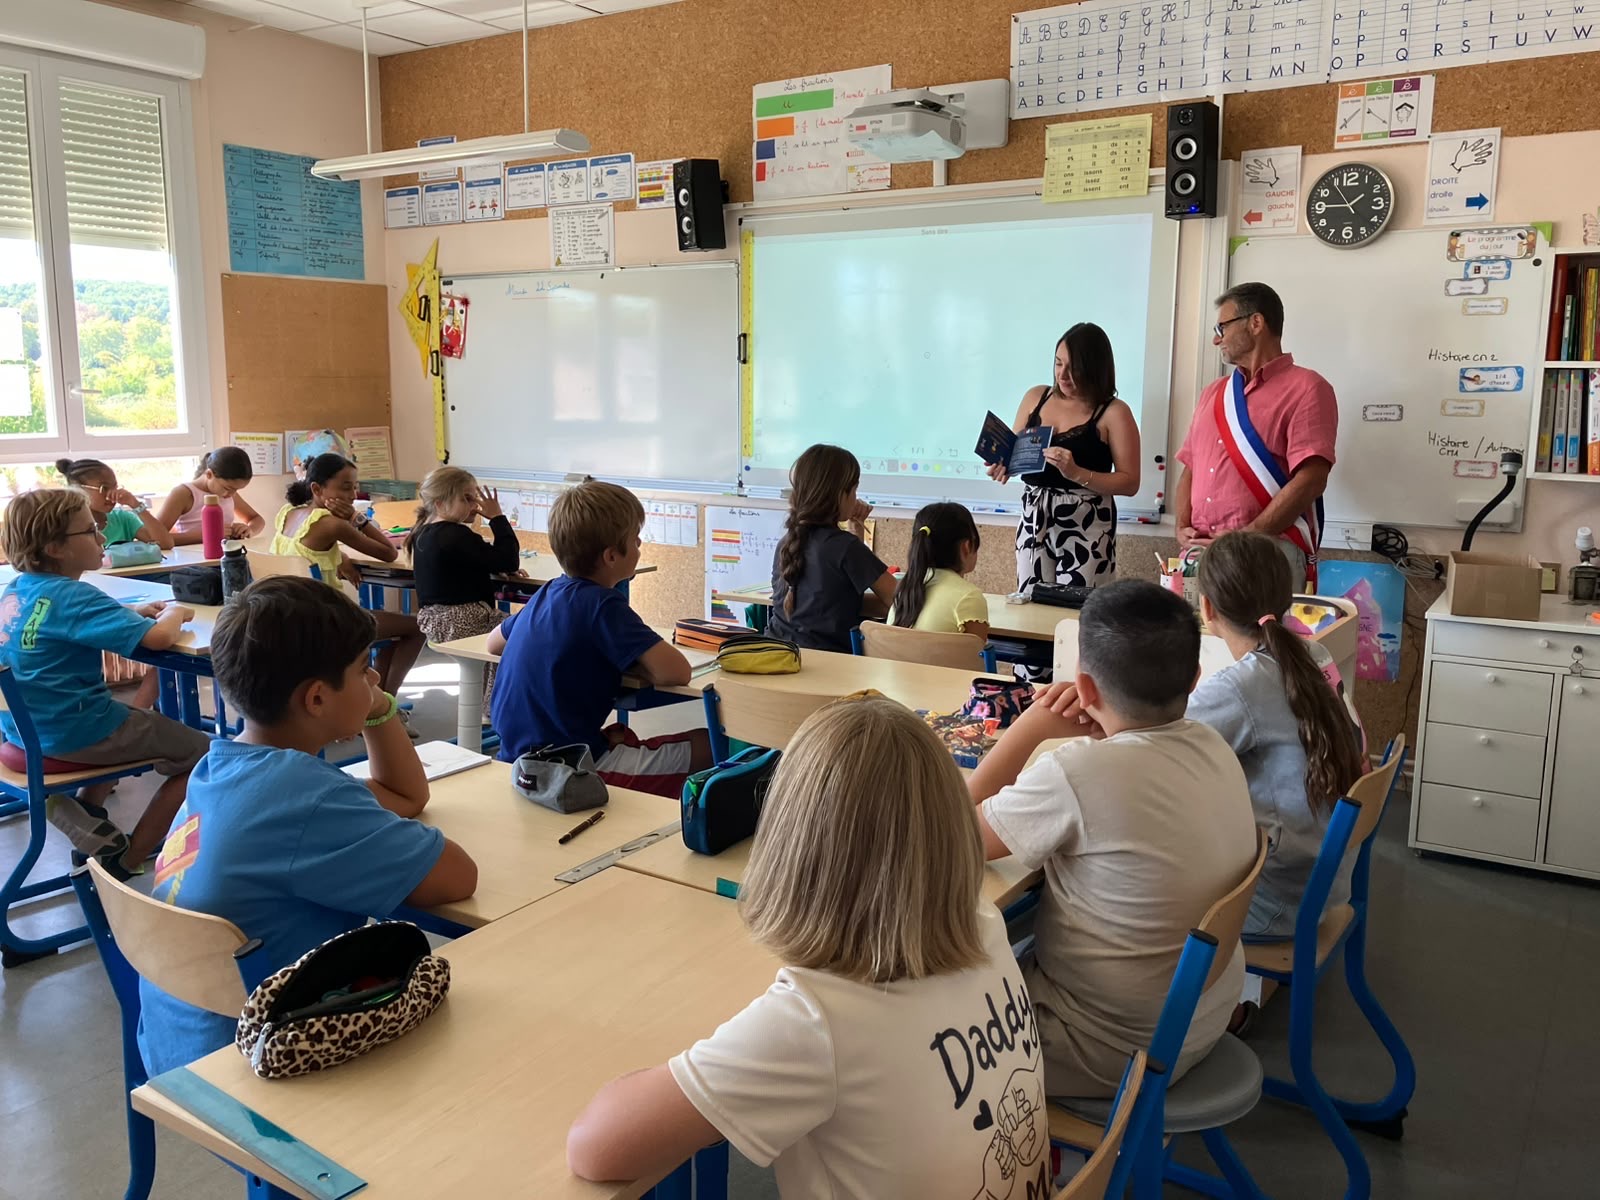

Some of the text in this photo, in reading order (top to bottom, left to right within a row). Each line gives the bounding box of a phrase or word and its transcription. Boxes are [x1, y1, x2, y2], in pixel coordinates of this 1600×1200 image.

[1039, 24, 1051, 41] B
[1079, 18, 1091, 36] D
[1358, 35, 1365, 48] p
[1400, 29, 1407, 42] q
[1332, 25, 1592, 69] O P Q R S T U V W
[1038, 74, 1044, 85] b
[1078, 68, 1083, 79] d
[1138, 64, 1144, 76] g
[1160, 57, 1165, 68] h
[1224, 47, 1229, 59] k
[1271, 46, 1280, 54] m
[1018, 97, 1027, 108] A
[1037, 95, 1043, 106] B
[1057, 92, 1065, 104] C
[1077, 90, 1085, 102] D
[1097, 87, 1103, 99] E
[1117, 85, 1122, 96] F
[1137, 81, 1147, 93] G
[1158, 79, 1167, 91] H
[1202, 74, 1207, 86] J
[1223, 70, 1231, 82] K
[1246, 68, 1252, 80] L
[1270, 64, 1283, 78] M
[1293, 61, 1305, 75] N
[1334, 178, 1339, 186] 11
[1343, 172, 1359, 186] 12
[1432, 177, 1458, 185] DROITE
[1265, 190, 1295, 198] GAUCHE
[1321, 189, 1329, 197] 10
[1373, 185, 1380, 193] 2
[1268, 202, 1294, 211] gauche
[1315, 202, 1326, 214] 9
[1371, 197, 1384, 209] 3
[1328, 229, 1335, 239] 7
[1342, 226, 1352, 239] 6
[1358, 623, 1373, 632] GNE
[930, 977, 1038, 1110] Daddy
